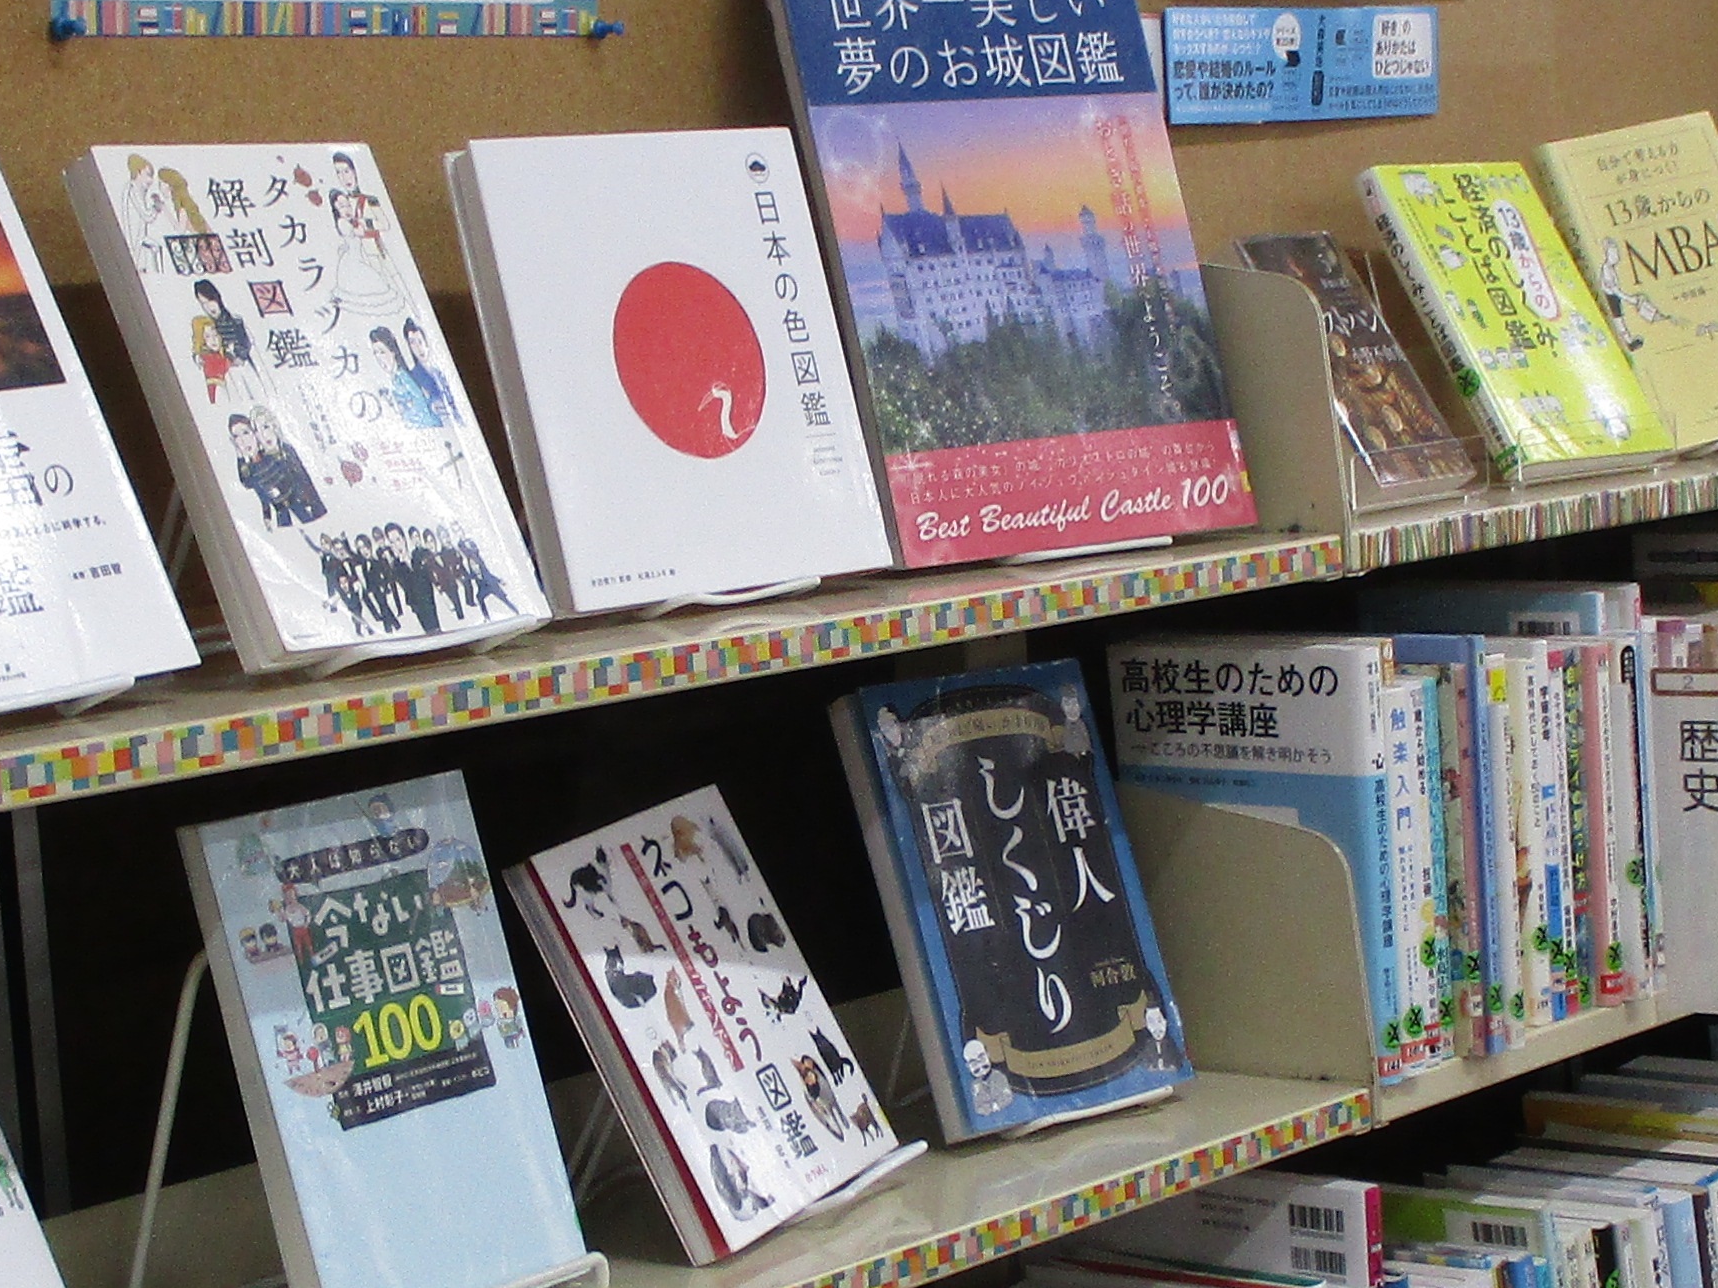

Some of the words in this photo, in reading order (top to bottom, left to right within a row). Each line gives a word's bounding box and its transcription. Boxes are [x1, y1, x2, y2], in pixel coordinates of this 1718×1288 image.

[832, 31, 1125, 95] 夢のお城図鑑
[1172, 59, 1276, 80] 恋愛や結婚のルール
[1603, 188, 1712, 228] 13歳からの
[207, 177, 320, 369] 解剖図鑑
[263, 176, 382, 423] タカラヅカの
[755, 190, 833, 428] 日本の色図鑑
[915, 511, 972, 541] Best
[979, 496, 1092, 533] Beautiful
[1100, 486, 1174, 522] Castle
[1181, 472, 1230, 508] 100
[1120, 658, 1340, 700] 高校生のための
[1125, 699, 1281, 740] 心理学講座
[286, 831, 424, 880] 大人は知らない
[920, 797, 996, 935] 図鑑
[1046, 776, 1115, 913] 偉人
[314, 890, 424, 949] 今ない
[976, 755, 1073, 1035] しくじり
[305, 928, 465, 1013] 仕事図鑑
[352, 993, 443, 1069] 100
